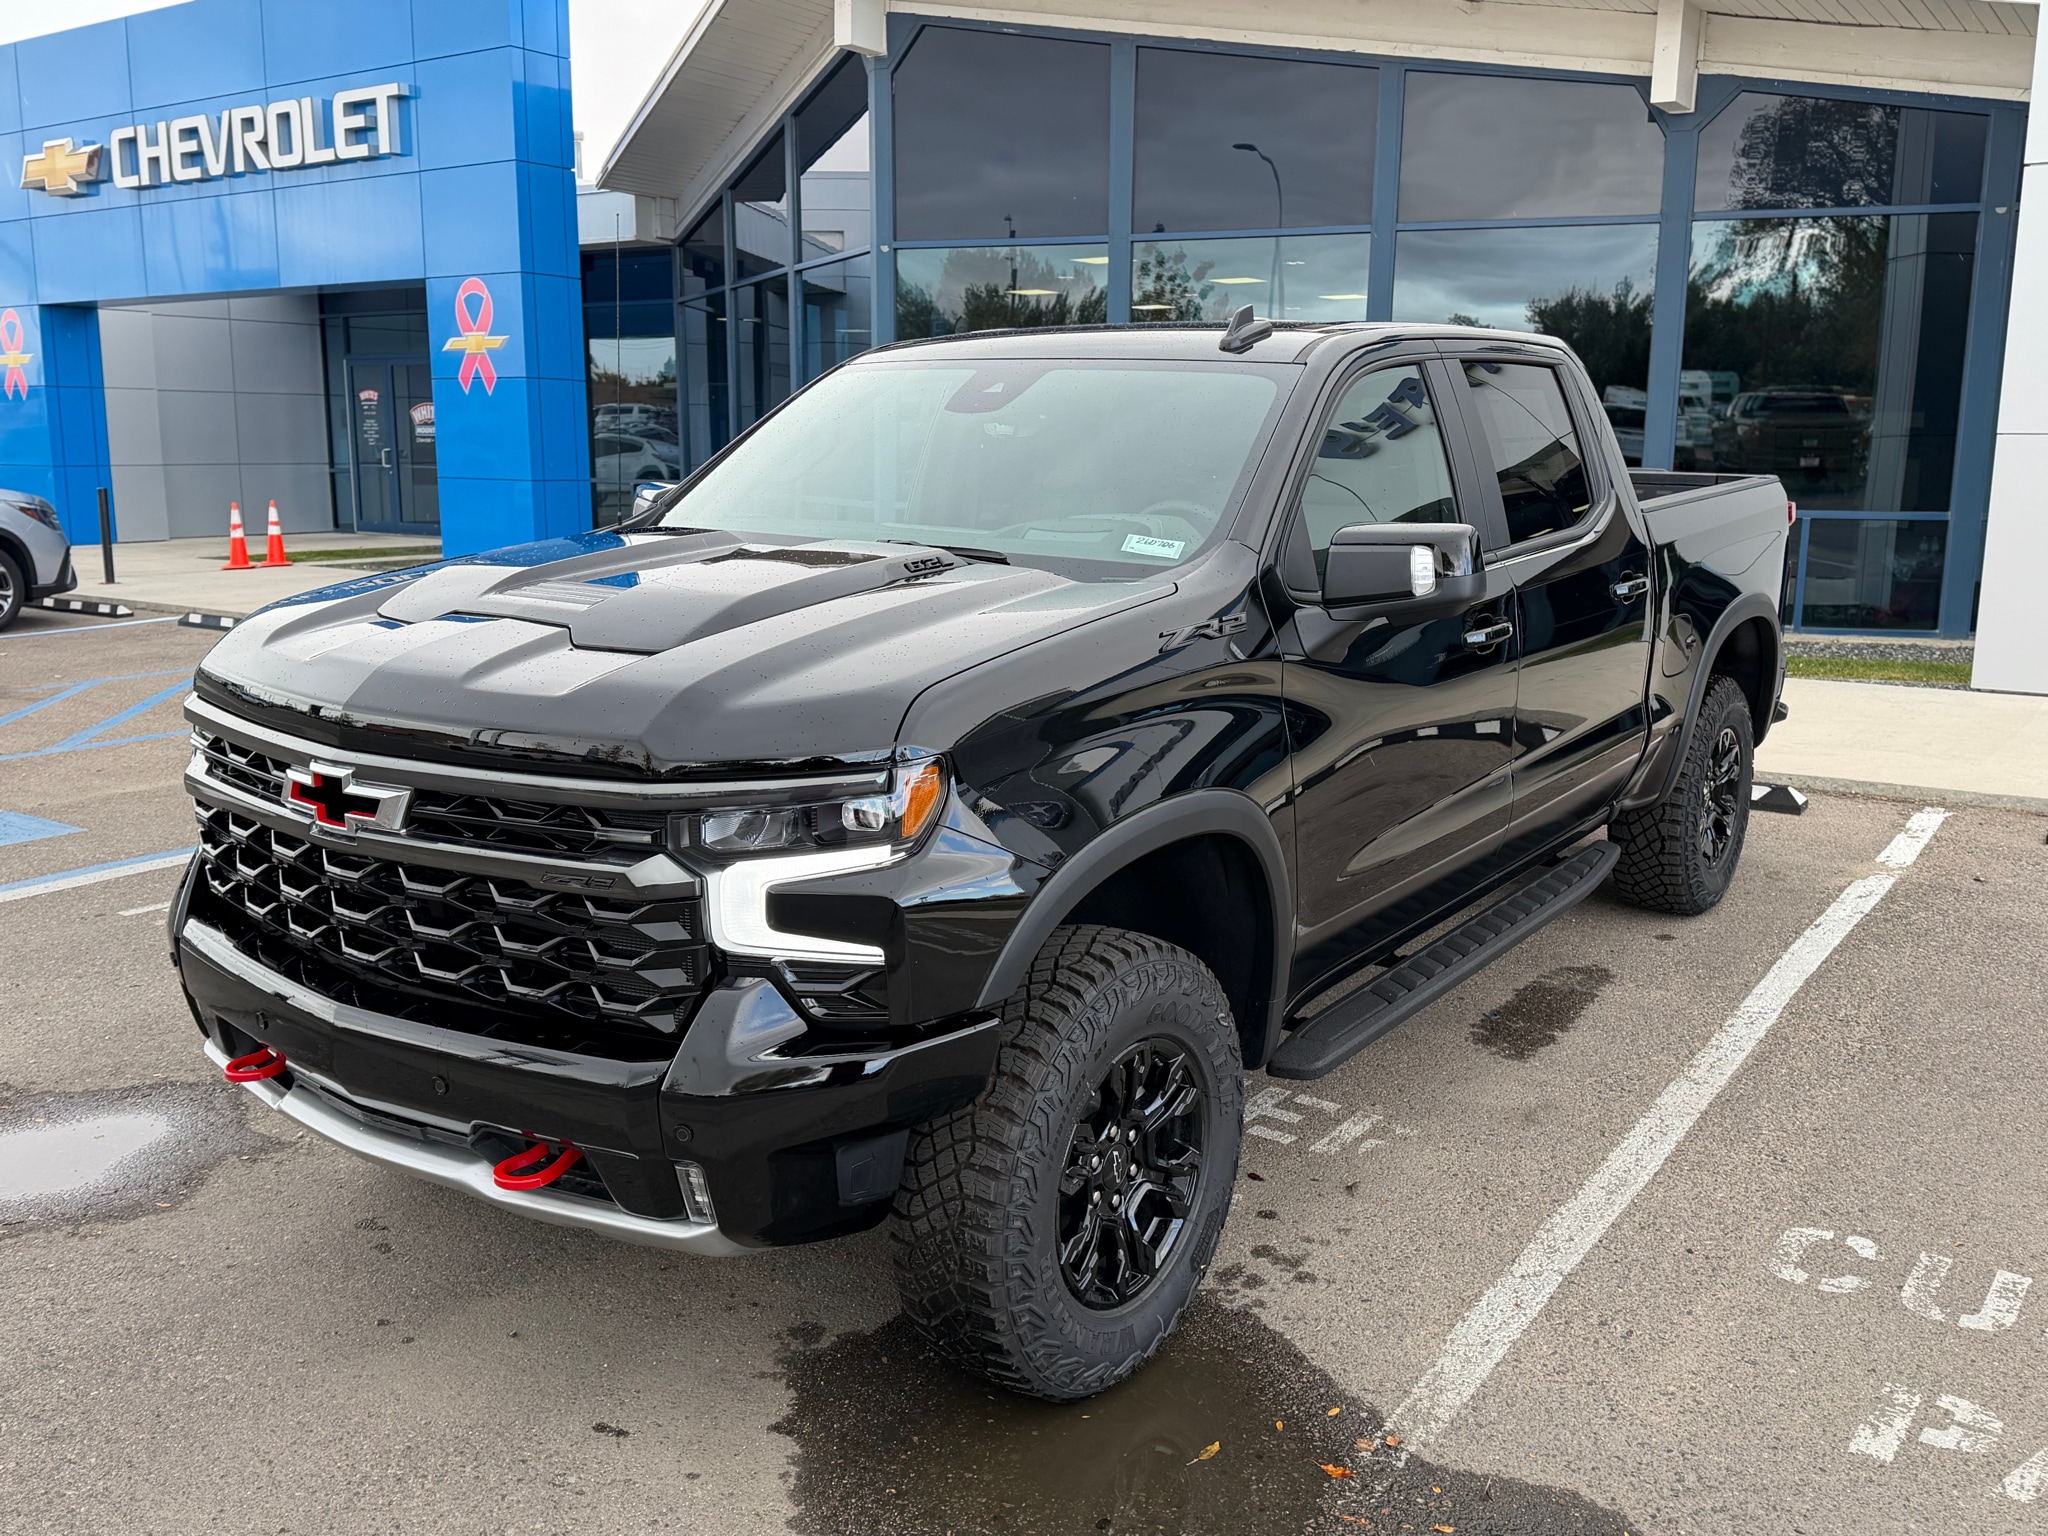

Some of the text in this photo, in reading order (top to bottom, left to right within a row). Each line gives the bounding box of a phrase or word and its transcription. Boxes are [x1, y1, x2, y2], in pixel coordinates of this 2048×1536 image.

[110, 82, 408, 189] CHEVROLET
[1159, 612, 1247, 654] ZR2
[540, 871, 618, 891] ZR2
[1147, 1001, 1235, 1117] GOODYEAR
[1040, 1252, 1138, 1357] WRANGLER
